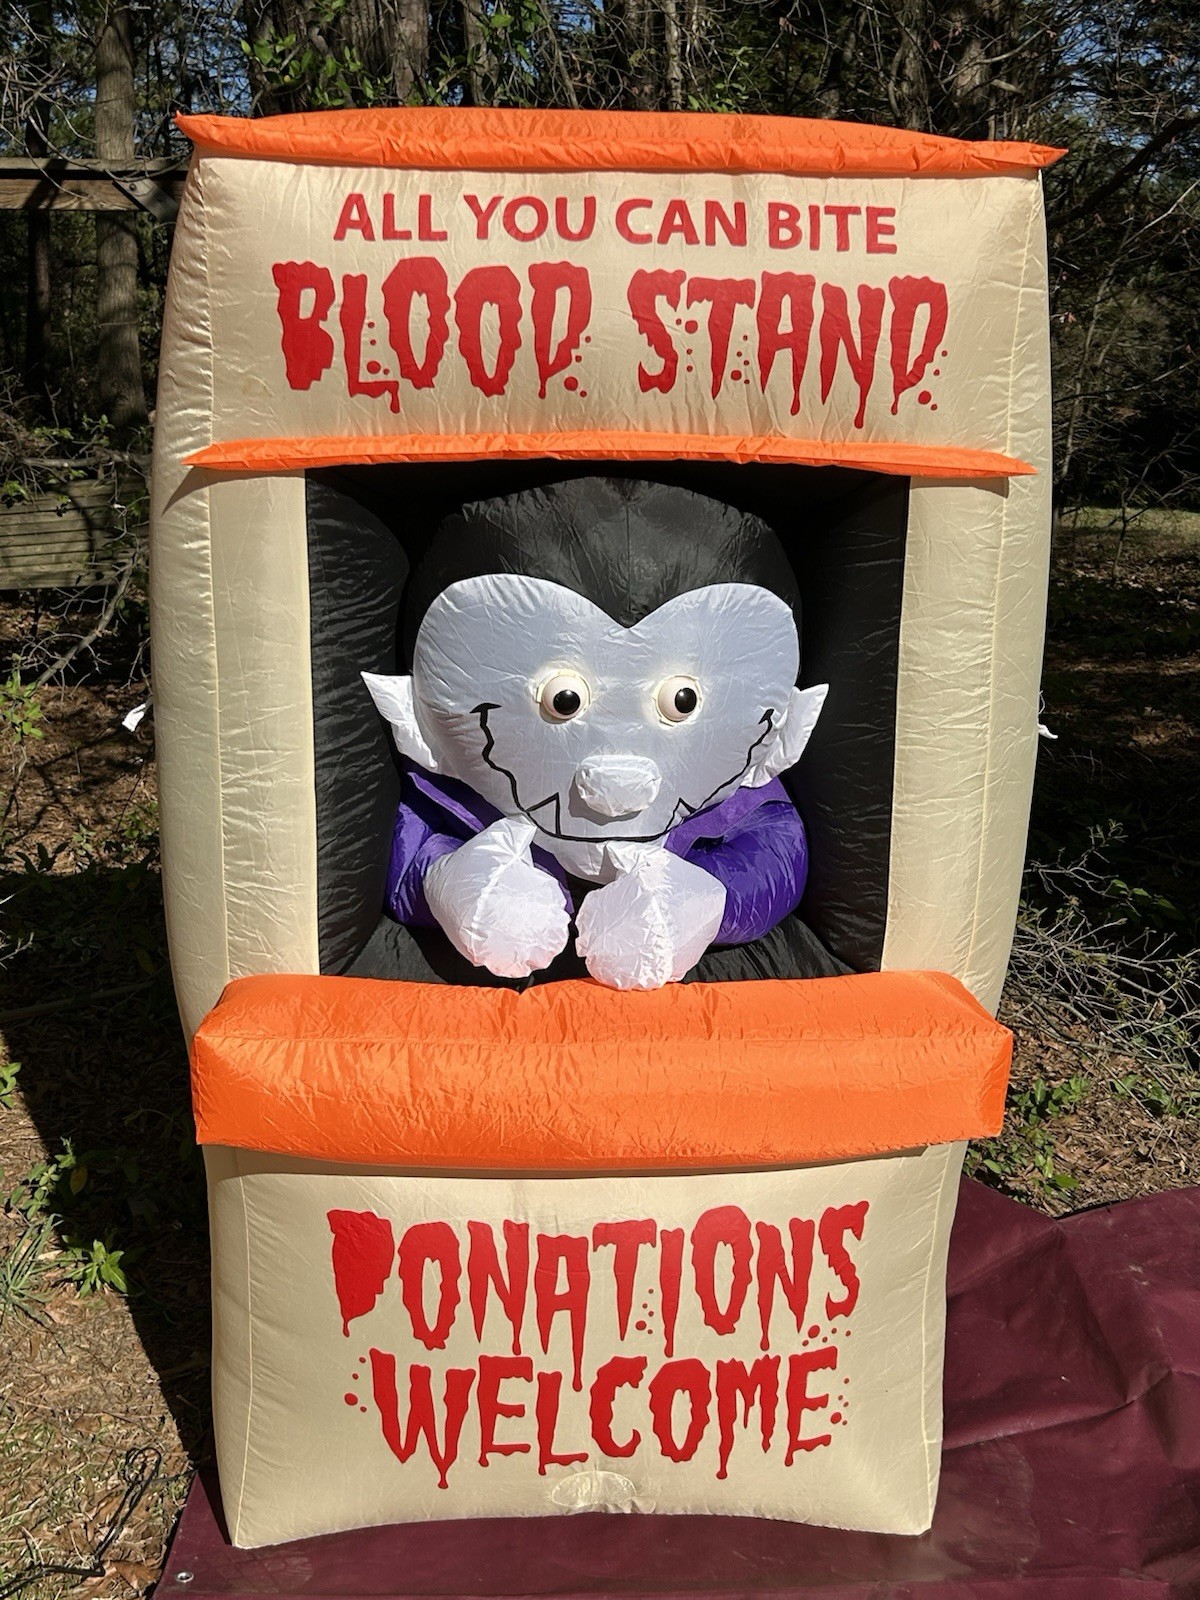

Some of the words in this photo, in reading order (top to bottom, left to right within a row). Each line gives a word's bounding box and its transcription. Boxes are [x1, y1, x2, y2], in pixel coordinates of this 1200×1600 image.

[334, 193, 448, 241] ALL
[463, 195, 597, 242] YOU
[615, 198, 747, 247] CAN
[768, 202, 897, 253] BITE
[271, 256, 592, 414] BLOOD
[628, 269, 949, 430] STAND
[326, 1200, 870, 1393] DONATIONS
[369, 1345, 838, 1489] WELCOME
